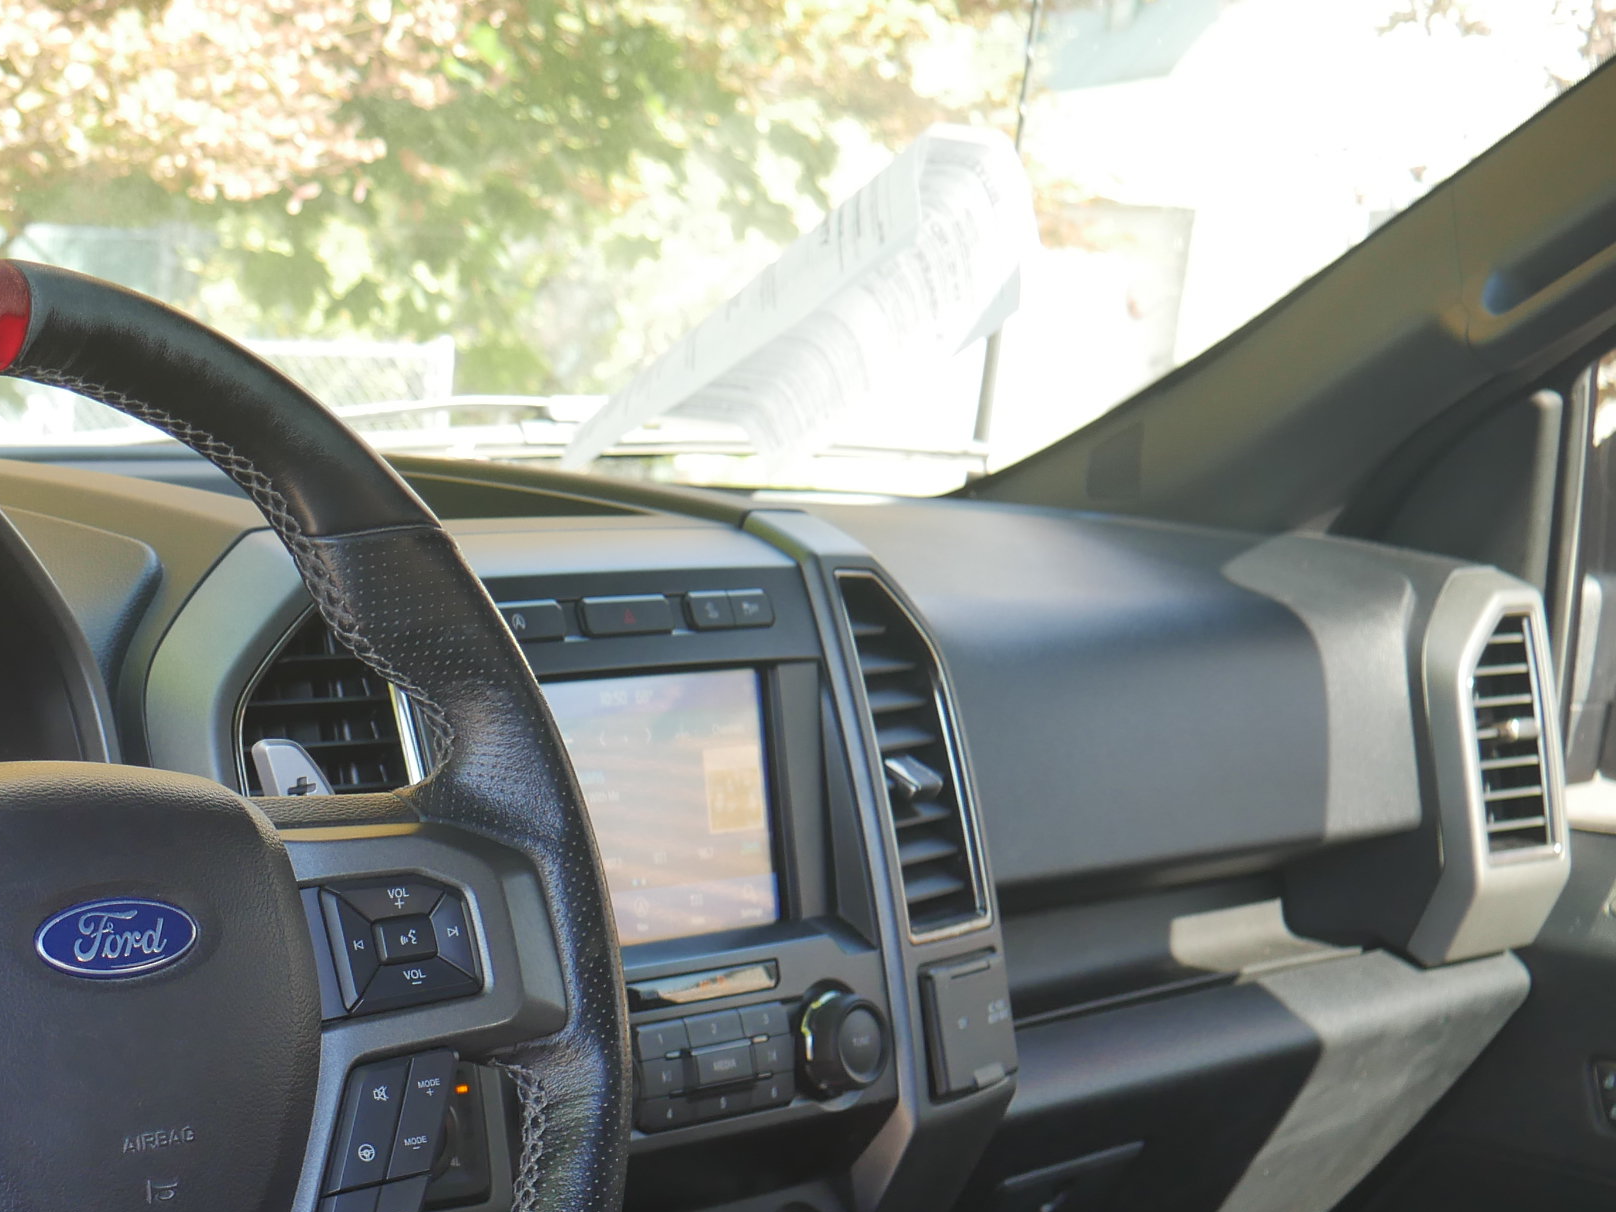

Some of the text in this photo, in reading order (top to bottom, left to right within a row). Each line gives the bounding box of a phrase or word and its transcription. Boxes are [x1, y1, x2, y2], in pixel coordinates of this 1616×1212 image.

[387, 887, 410, 899] VOL
[73, 909, 168, 963] Ford
[403, 968, 427, 981] VOL
[417, 1078, 441, 1089] MODE
[122, 1124, 195, 1154] AIRBAG
[403, 1135, 428, 1146] MODE
